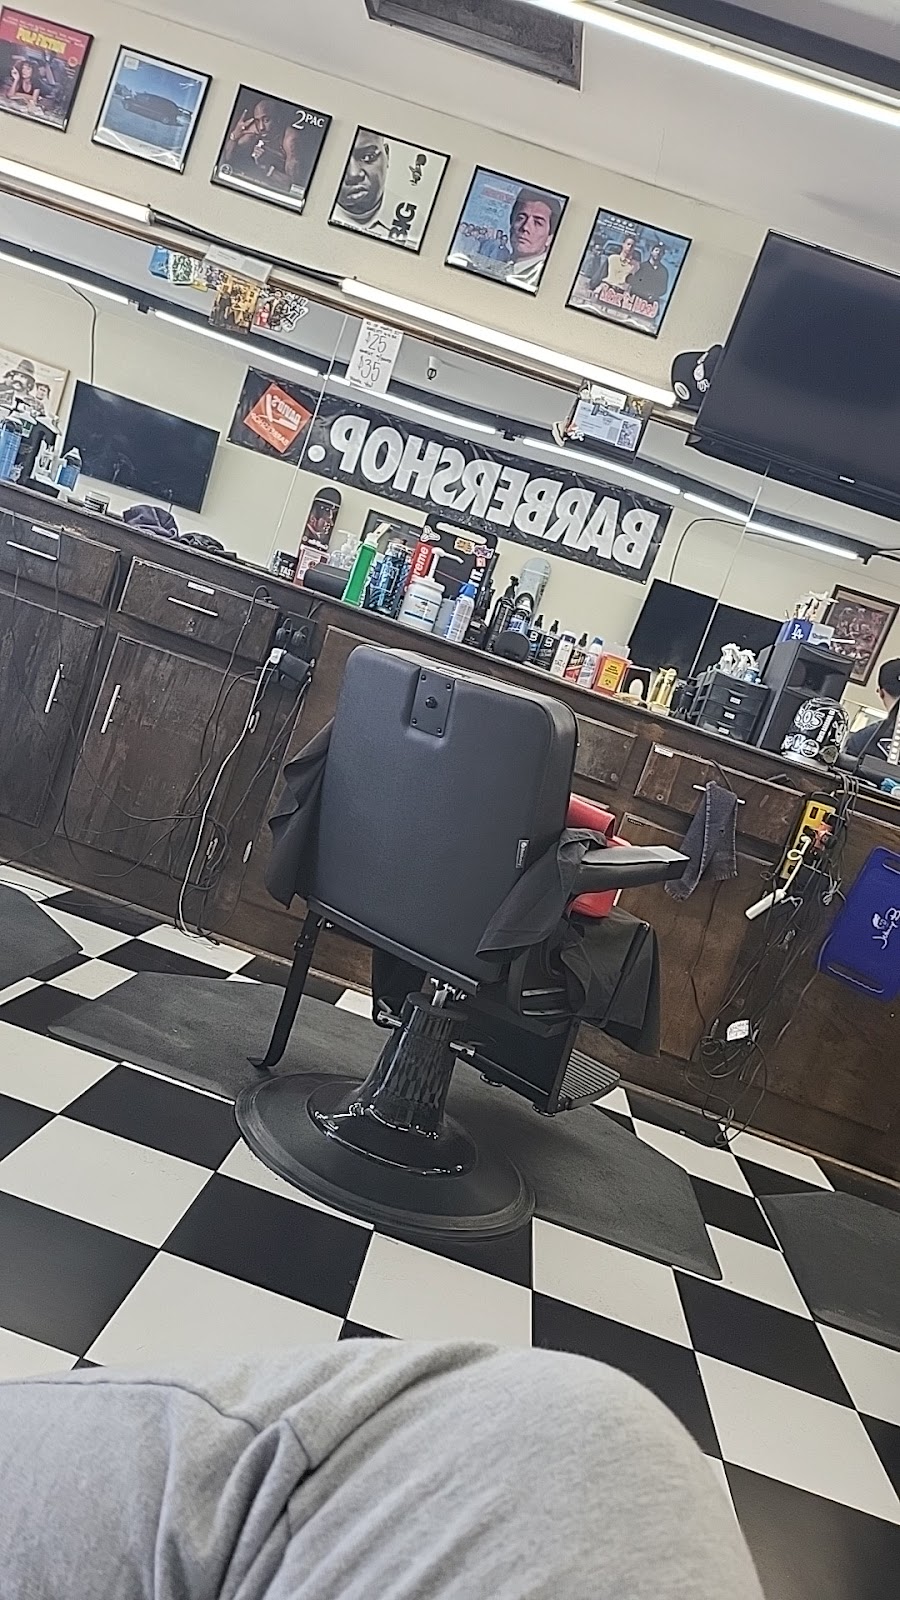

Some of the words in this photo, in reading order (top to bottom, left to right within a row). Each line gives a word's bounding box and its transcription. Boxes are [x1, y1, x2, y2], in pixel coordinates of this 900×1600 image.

[292, 110, 325, 130] 2PAC
[365, 331, 387, 353] $25
[358, 355, 380, 382] $35
[791, 624, 804, 640] LA
